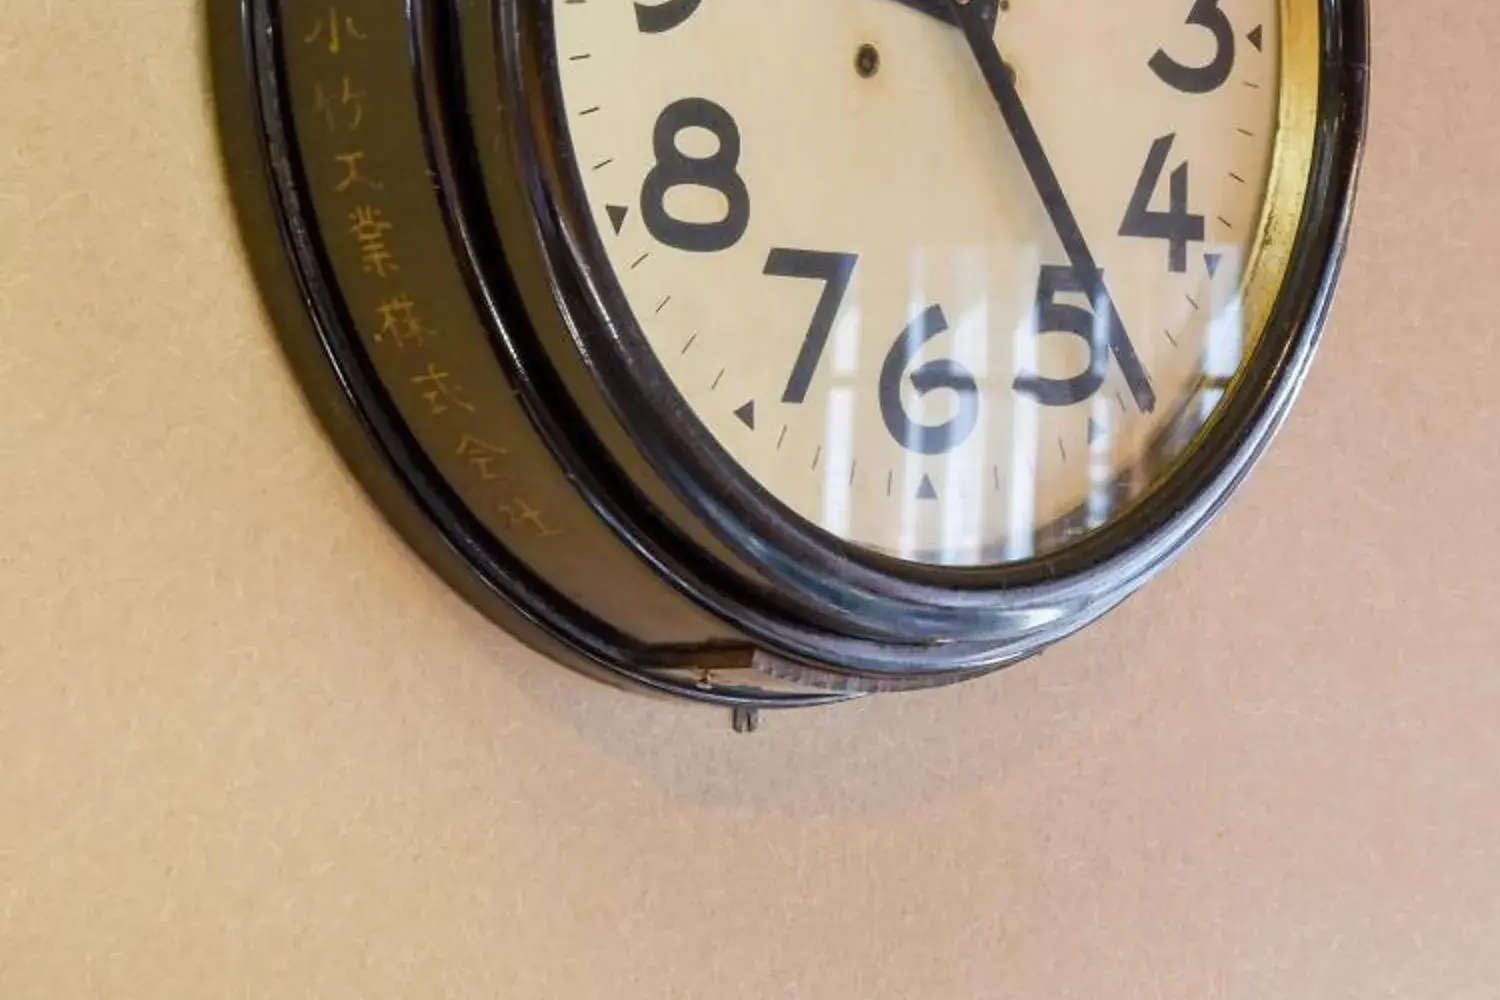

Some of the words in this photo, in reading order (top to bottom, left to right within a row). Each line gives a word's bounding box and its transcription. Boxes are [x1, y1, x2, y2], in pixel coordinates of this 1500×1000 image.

[640, 98, 749, 252] 8
[1119, 134, 1204, 271] 4
[763, 248, 857, 403] 7
[879, 305, 979, 454] 6
[1012, 264, 1109, 406] 5
